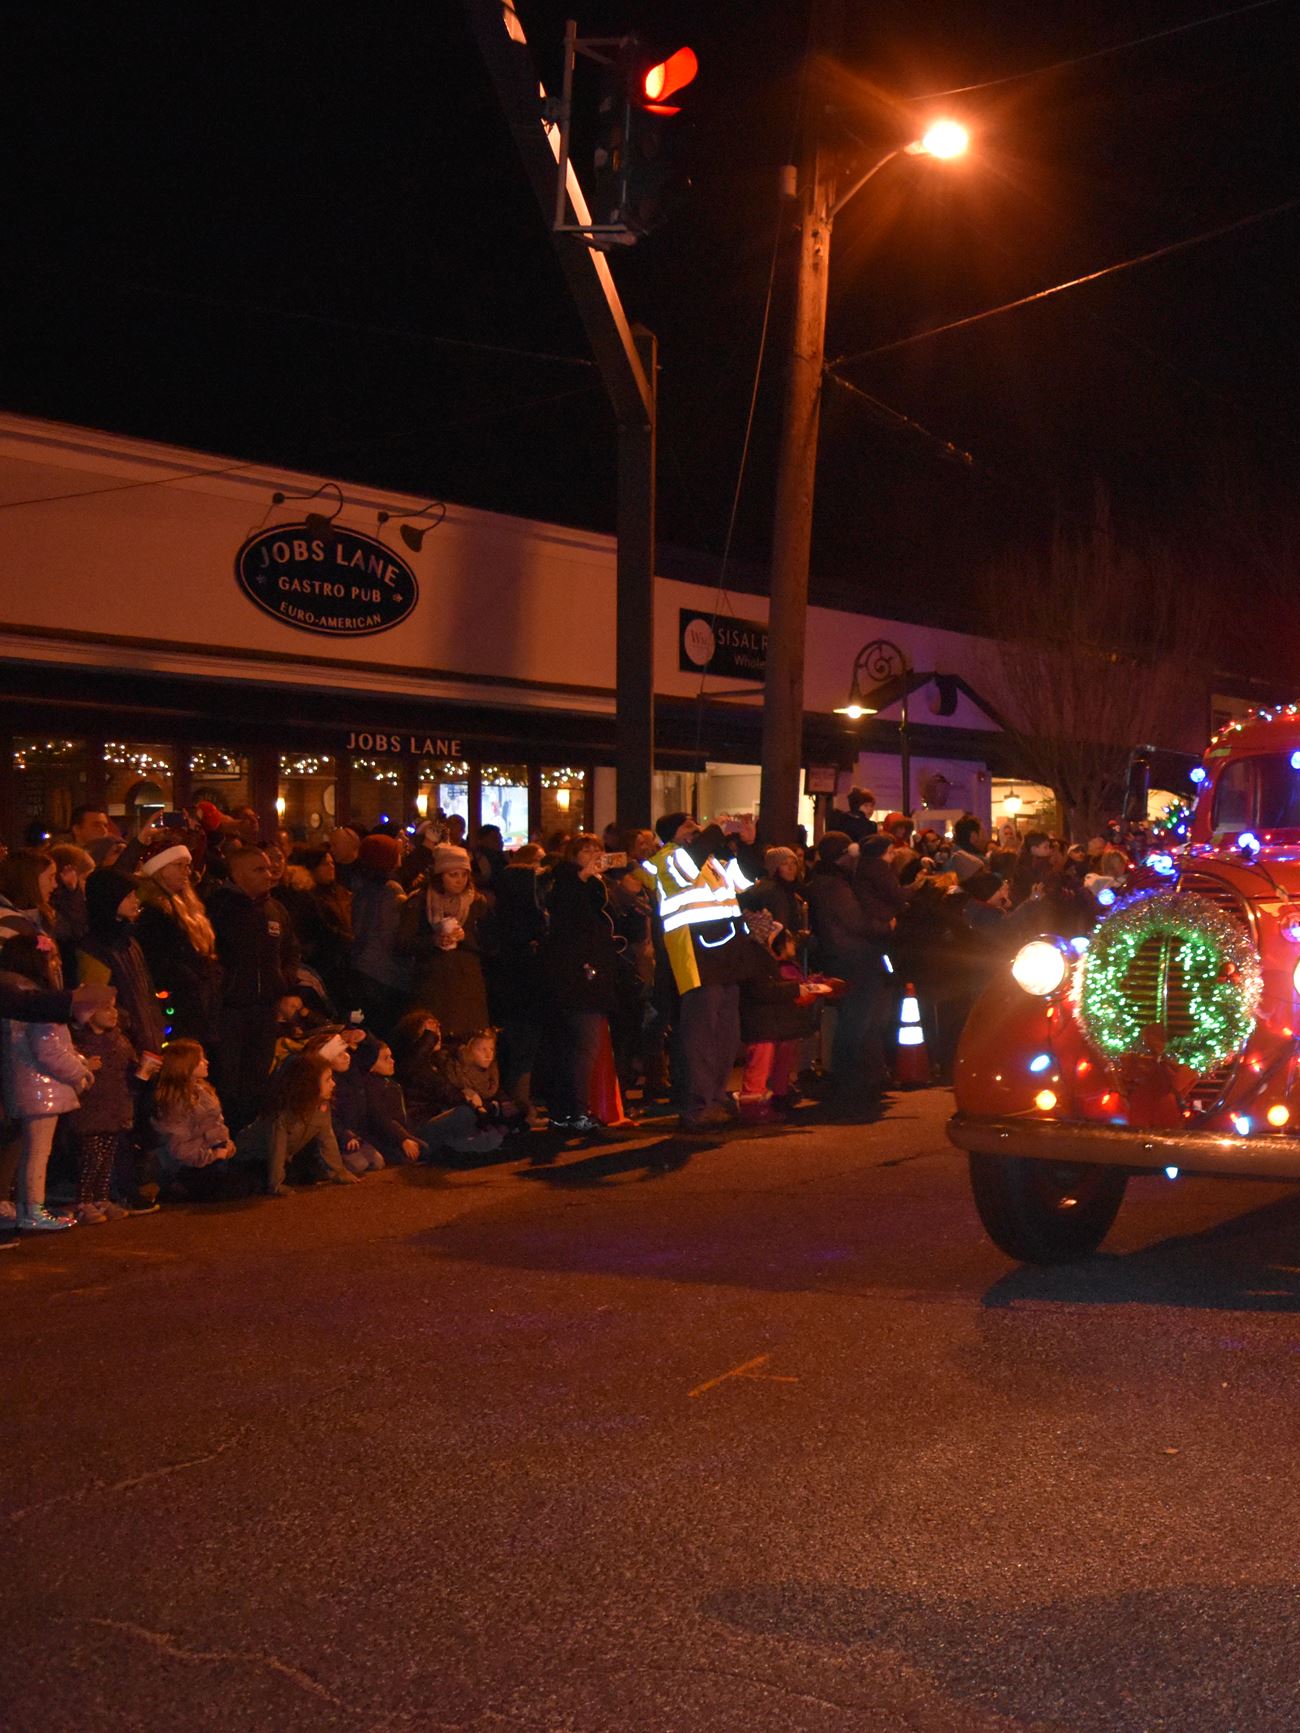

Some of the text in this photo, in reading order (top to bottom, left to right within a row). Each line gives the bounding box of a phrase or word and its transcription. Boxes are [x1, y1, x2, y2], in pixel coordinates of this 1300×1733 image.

[260, 540, 399, 587] JOBS LANE
[278, 576, 381, 603] GASTRO PUB
[280, 601, 381, 628] EURO-AMERICAN
[718, 627, 759, 650] SISAL
[346, 732, 462, 757] JOBS LANE
